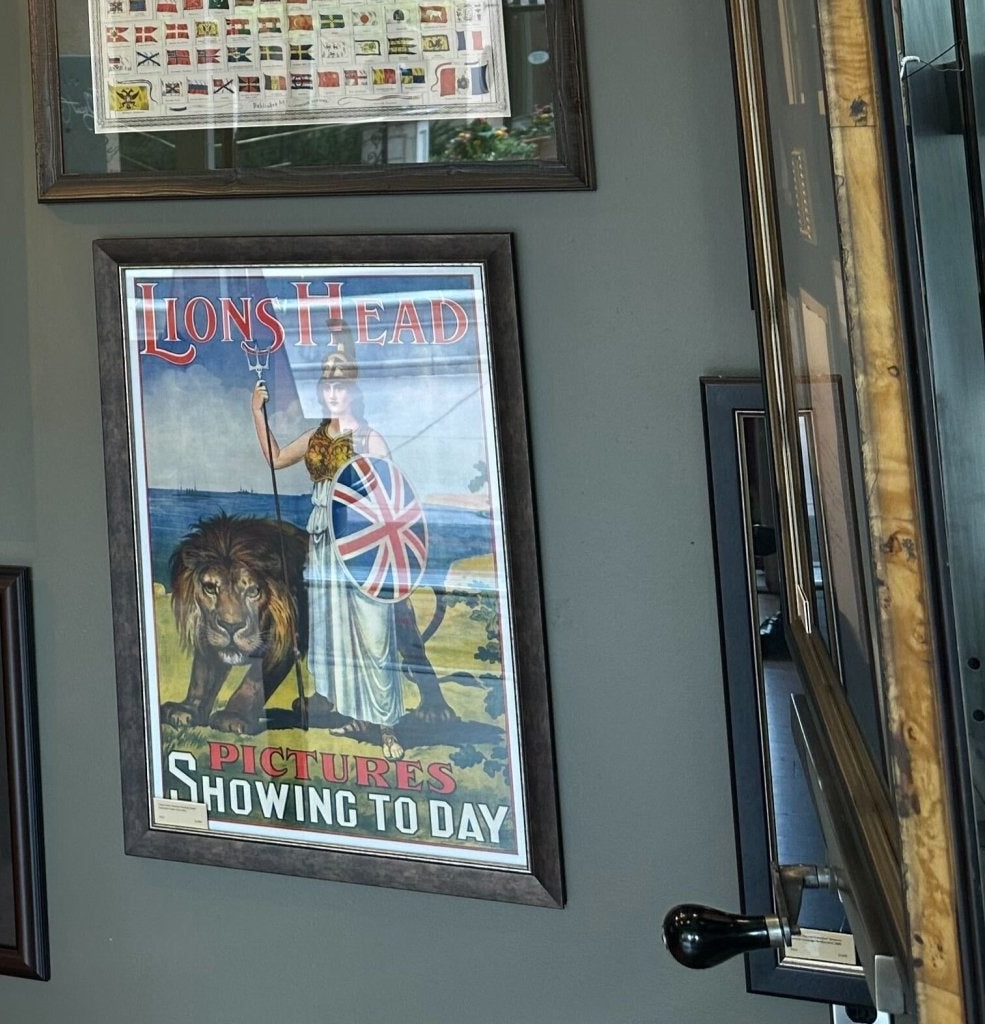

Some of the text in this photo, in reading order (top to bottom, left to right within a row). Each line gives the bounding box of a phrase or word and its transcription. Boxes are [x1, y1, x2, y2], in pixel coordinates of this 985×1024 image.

[290, 281, 469, 347] HEAD
[168, 750, 357, 829] SHOWING
[368, 793, 419, 836] TO
[429, 799, 509, 844] DAY
[207, 740, 457, 795] PICTURES
